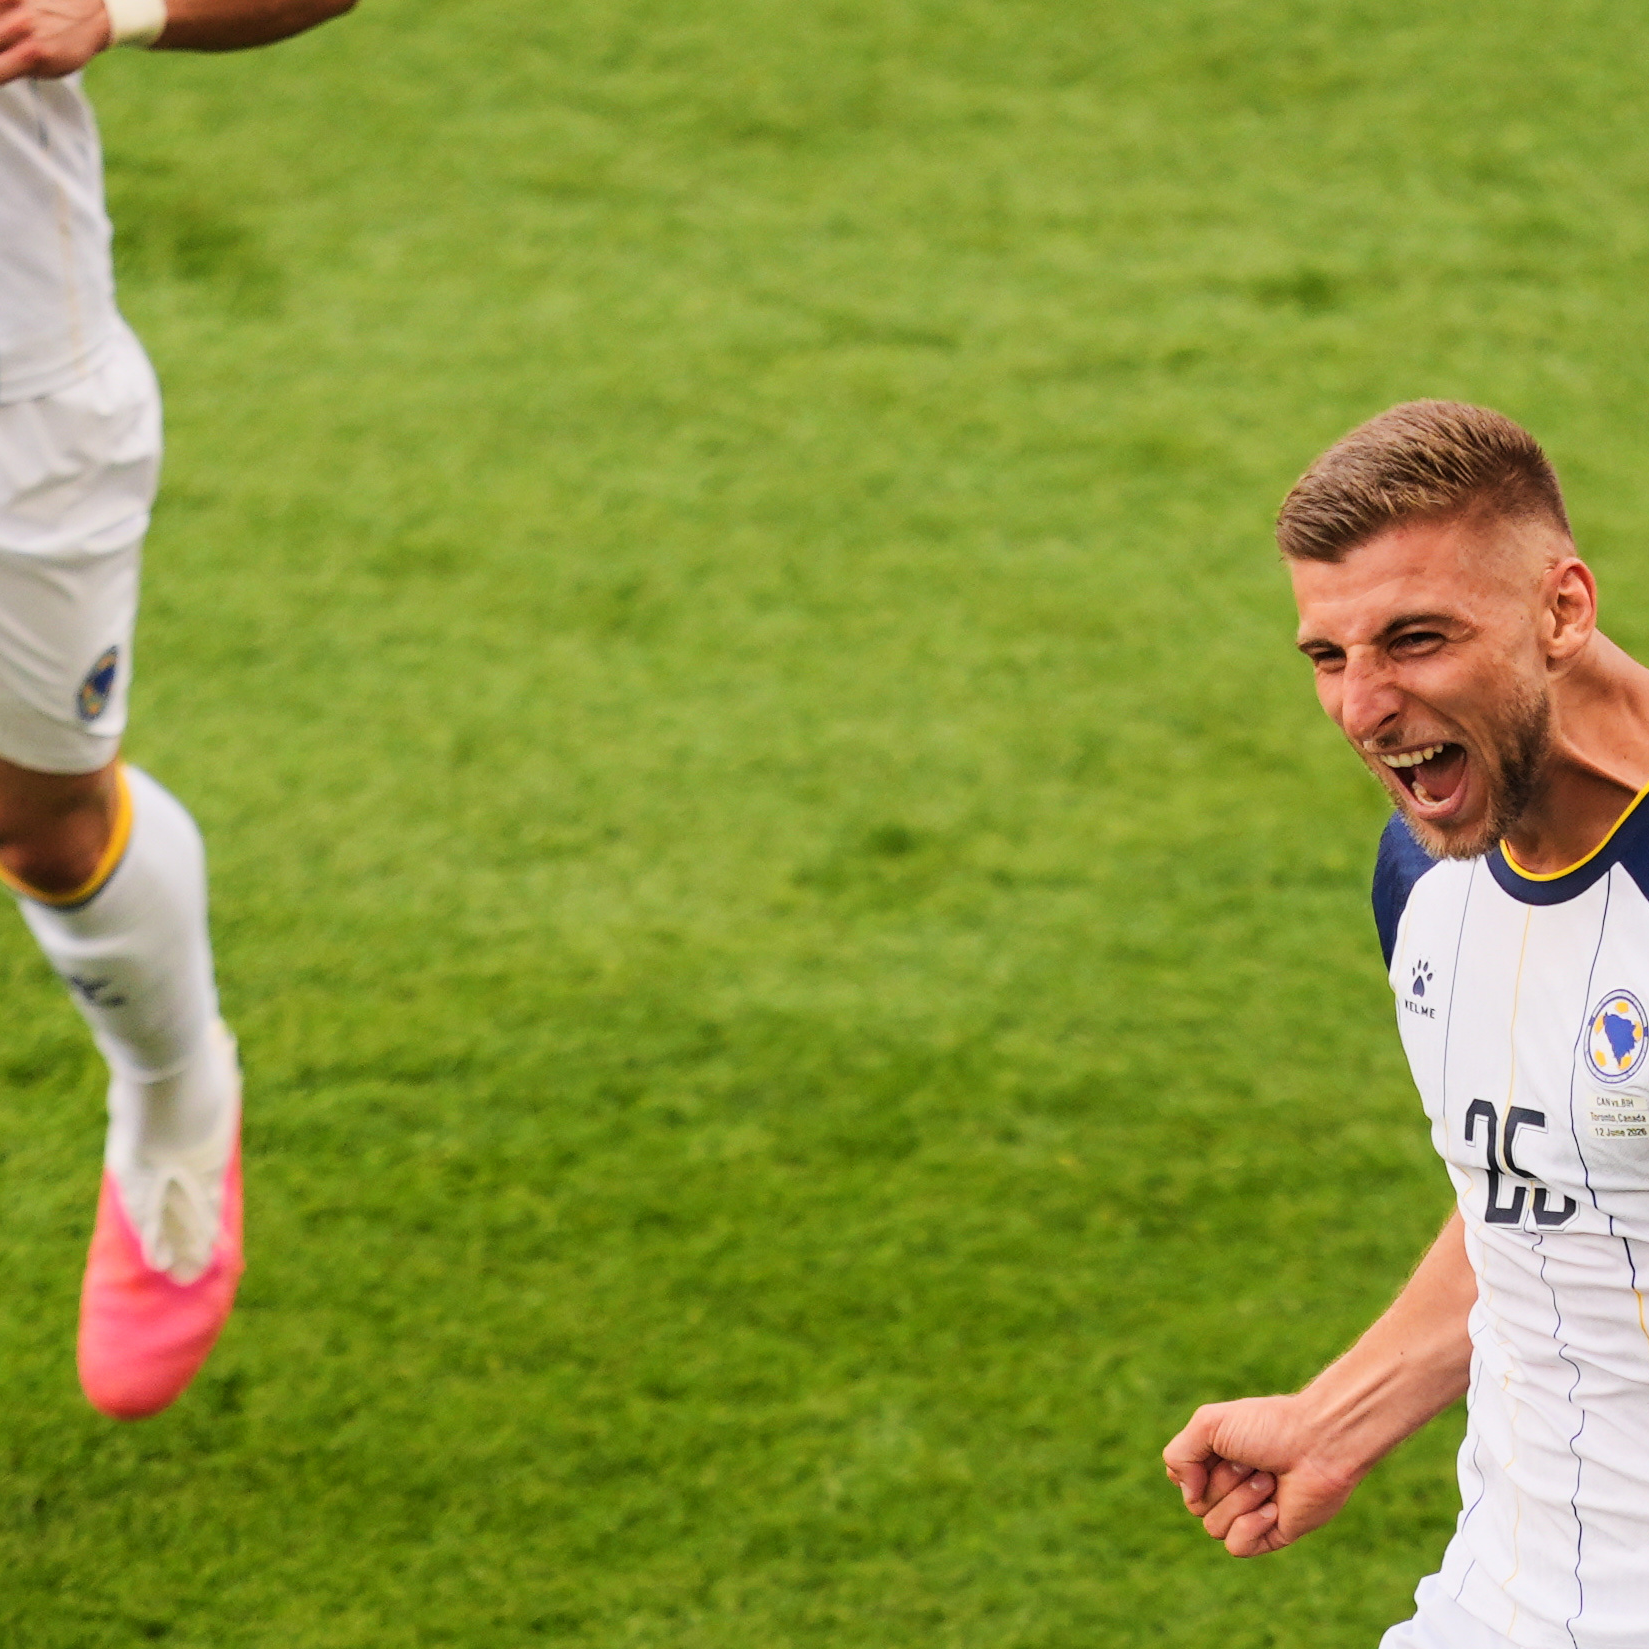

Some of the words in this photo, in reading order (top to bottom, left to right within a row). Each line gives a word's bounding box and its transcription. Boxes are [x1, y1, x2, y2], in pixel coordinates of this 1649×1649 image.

[1464, 1098, 1578, 1228] 25
[1595, 1127, 1604, 1137] 12
[1606, 1127, 1626, 1137] June
[1626, 1127, 1648, 1137] 2026
